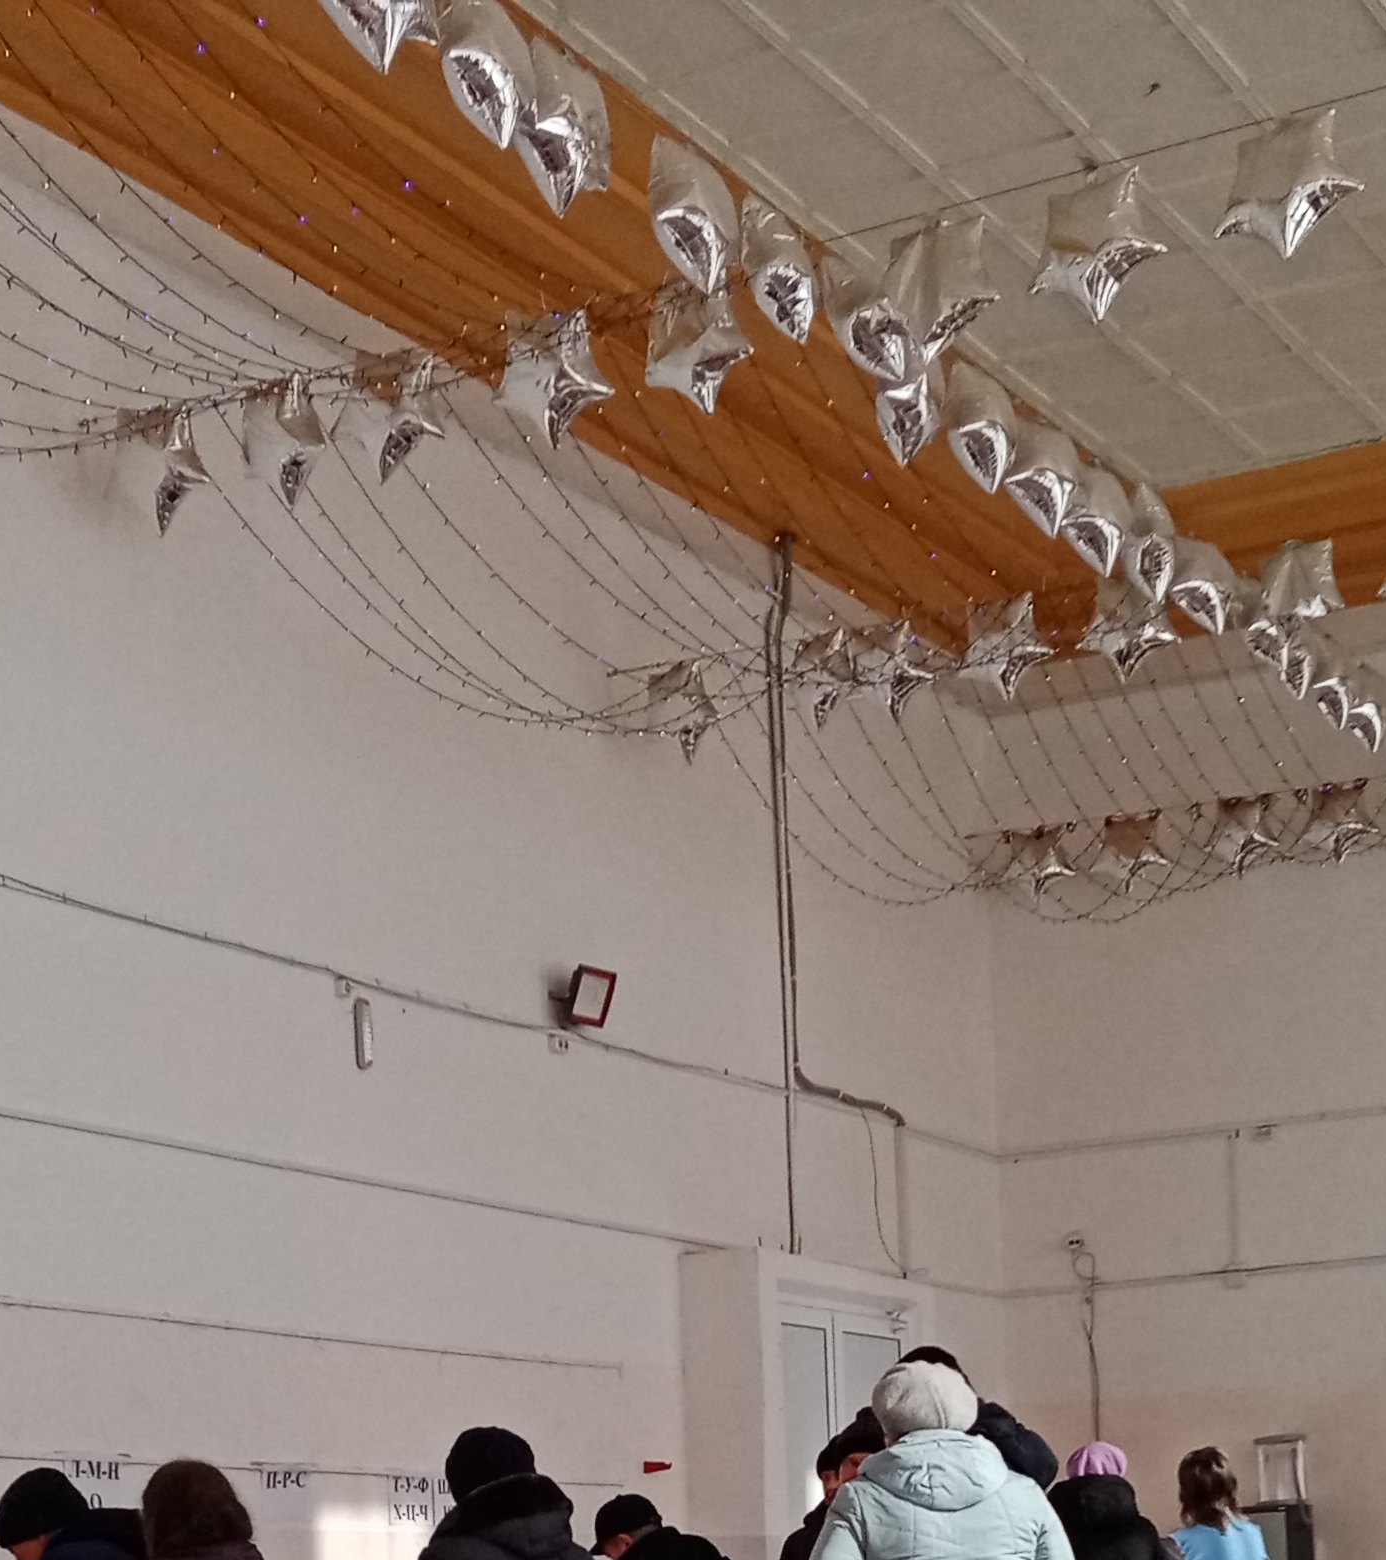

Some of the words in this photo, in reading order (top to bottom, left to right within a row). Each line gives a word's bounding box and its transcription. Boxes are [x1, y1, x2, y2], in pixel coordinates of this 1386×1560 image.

[68, 1460, 120, 1480] Л-М-Н
[266, 1471, 307, 1489] П-Р-С
[392, 1476, 429, 1493] Т-У-Ф
[393, 1503, 428, 1523] Х-Ц-Ч
